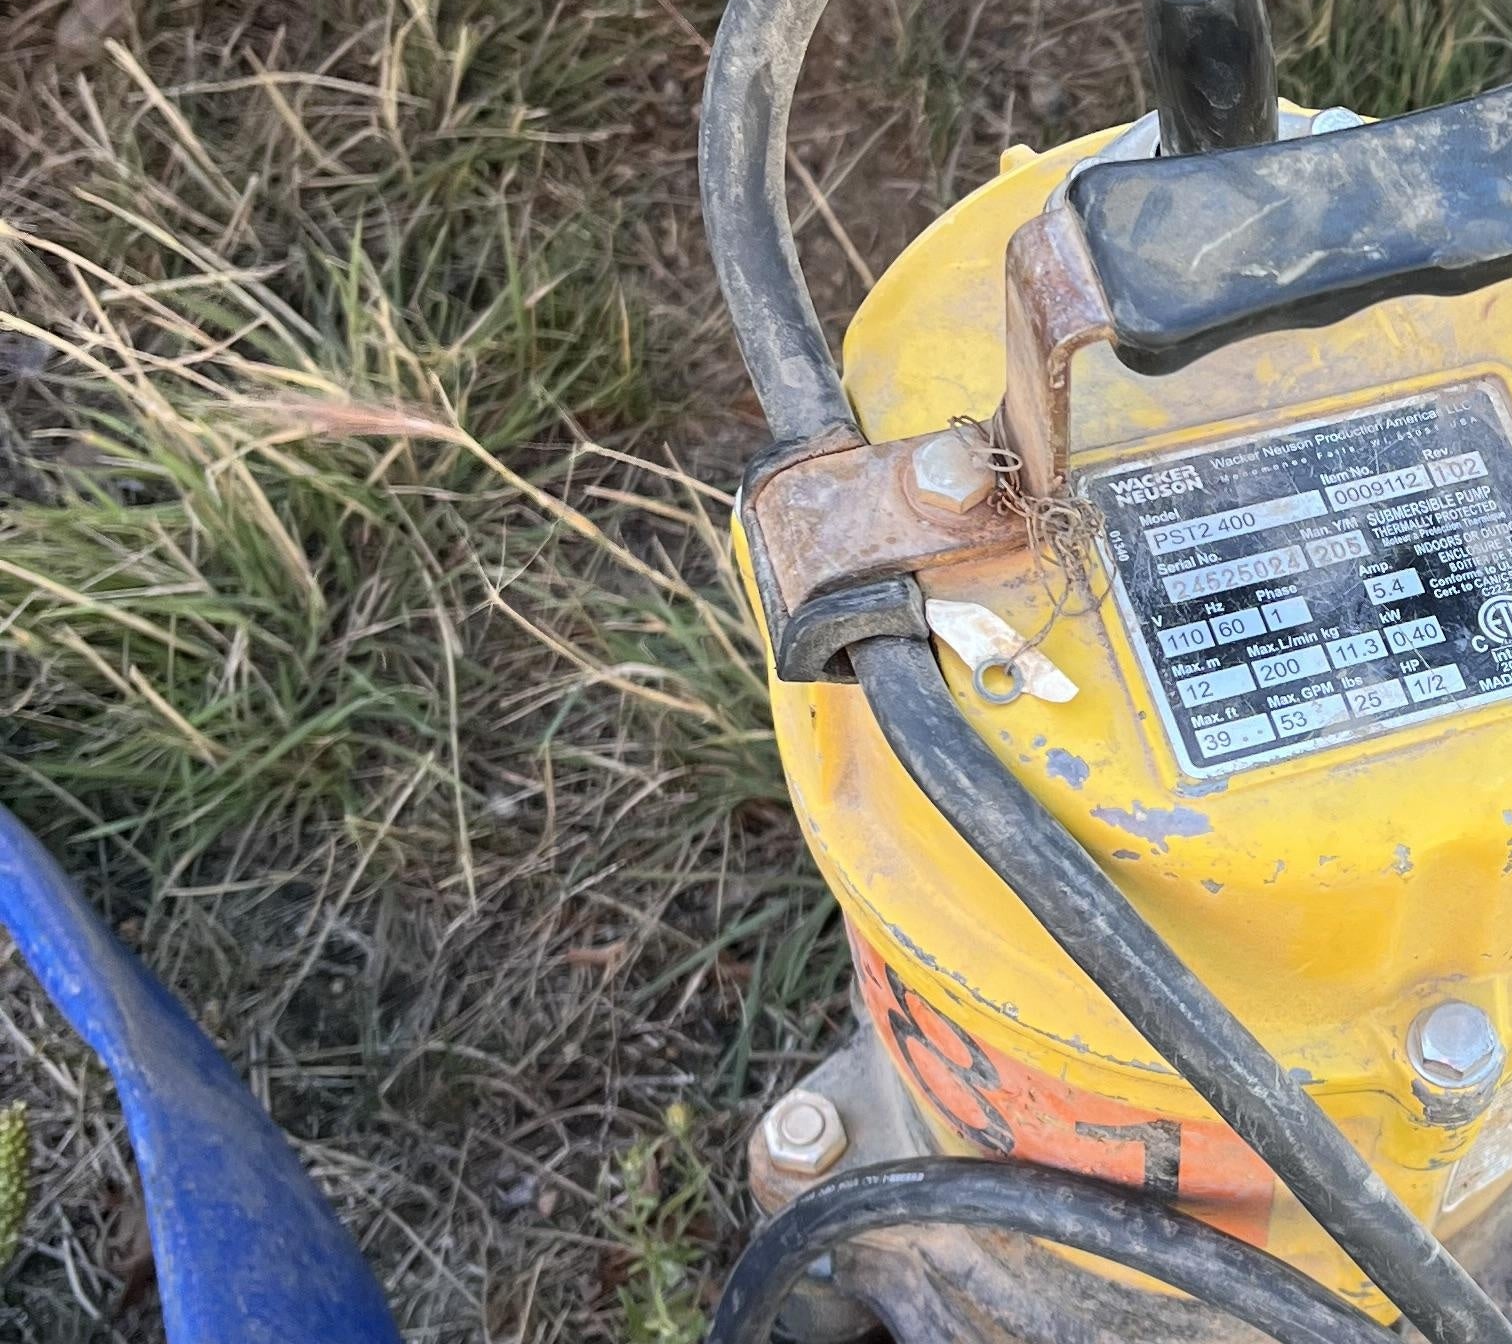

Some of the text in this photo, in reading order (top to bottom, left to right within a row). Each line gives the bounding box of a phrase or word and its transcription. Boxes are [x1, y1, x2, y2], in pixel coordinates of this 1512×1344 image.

[1212, 450, 1260, 468] Wacker
[1262, 438, 1314, 456] Neuson
[1314, 421, 1384, 444] Production
[1444, 400, 1474, 414] LLC
[1422, 445, 1452, 458] Rev.
[1110, 464, 1198, 494] WACKER
[1320, 464, 1374, 484] Item No.
[1436, 458, 1480, 482] 102
[1116, 477, 1204, 506] NEUSON
[1334, 473, 1420, 504] 0009112
[1366, 486, 1492, 526] SUBMERSIBLE PUMP
[1140, 509, 1180, 526] Model
[1372, 500, 1498, 538] THERMALLY PROTECTED
[1154, 512, 1256, 548] PST2 400
[1300, 518, 1358, 540] Man. Y/M
[1420, 521, 1462, 536] Protection
[1110, 531, 1130, 560] 01340
[1414, 535, 1462, 554] INDOORS
[1462, 531, 1480, 542] OR
[1438, 539, 1504, 562] ENCLOSURE
[1156, 551, 1222, 574] Serial No.
[1492, 552, 1506, 560] DE
[1358, 560, 1394, 576] Amp.
[1484, 564, 1496, 574] to
[1256, 582, 1298, 600] Phase
[1372, 579, 1406, 598] 5.4
[1434, 586, 1460, 598] Cert.
[1460, 582, 1474, 590] to
[1204, 601, 1226, 614] Hz
[1272, 610, 1282, 622] 1
[1378, 609, 1404, 622] kW
[1152, 616, 1164, 626] V
[1218, 619, 1246, 636] 60
[1168, 629, 1206, 650] 110
[1320, 625, 1342, 640] kg
[1392, 624, 1438, 646] 0.40
[1246, 631, 1318, 656] Max. L/min
[1336, 638, 1380, 662] 11.3
[1470, 636, 1490, 652] C
[1172, 657, 1220, 676] Max. m
[1260, 659, 1302, 680] 200
[1400, 660, 1422, 672] HP
[1186, 681, 1214, 700] 12
[1342, 675, 1364, 688] lbs
[1414, 675, 1446, 694] 1/2
[1266, 682, 1334, 708] Max. GPM
[1354, 692, 1382, 710] 25
[1190, 707, 1238, 728] Max. ft
[1280, 711, 1308, 730] 53
[1204, 731, 1232, 750] 39
